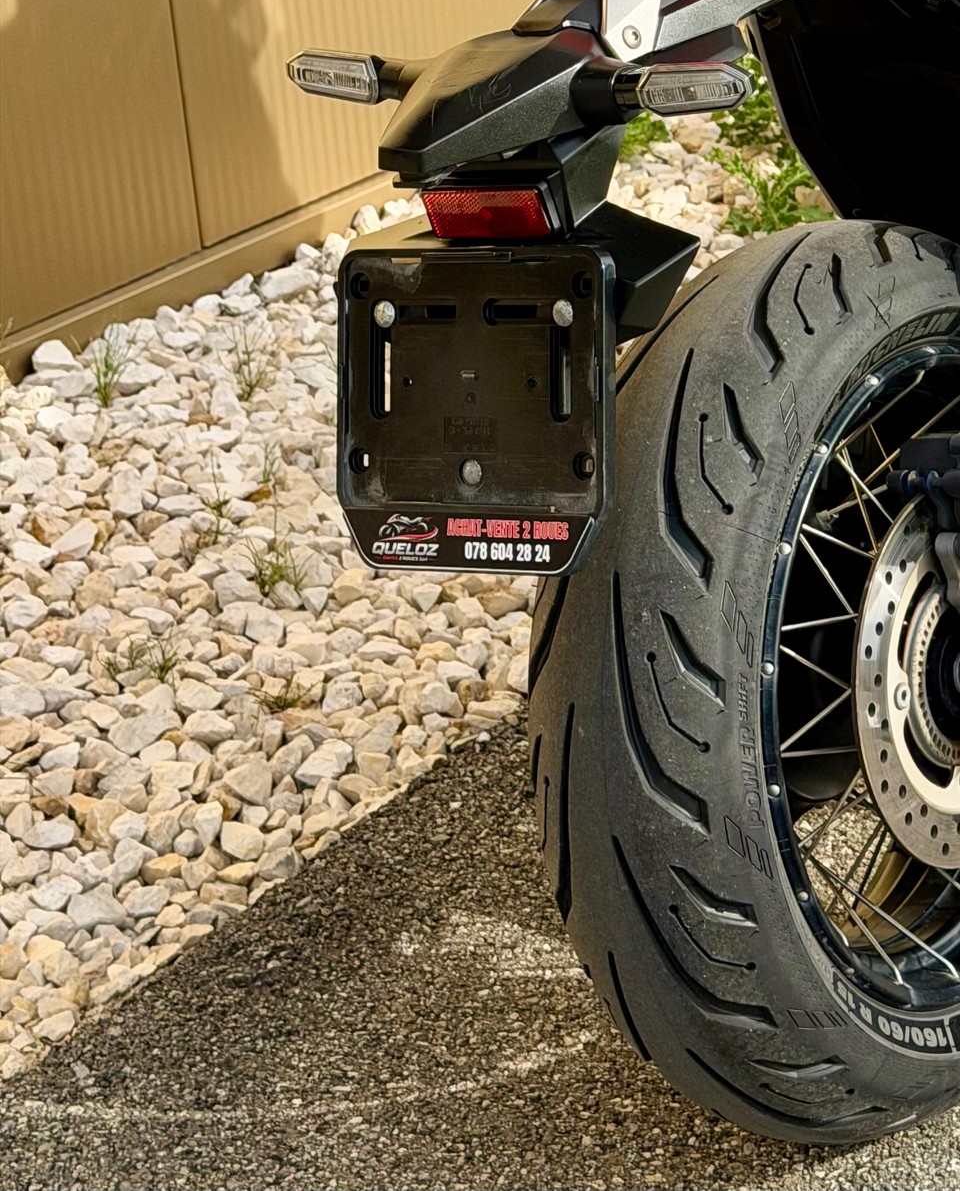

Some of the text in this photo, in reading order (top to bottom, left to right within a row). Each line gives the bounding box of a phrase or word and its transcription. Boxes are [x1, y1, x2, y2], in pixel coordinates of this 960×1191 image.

[446, 518, 569, 541] ACHAT-VENTE 2 ROUES
[371, 541, 440, 557] QUELOZ
[464, 541, 550, 564] 078 604 28 24
[737, 673, 762, 829] POWER SHIFT
[859, 1003, 873, 1026] R
[878, 1015, 948, 1048] 160/60
